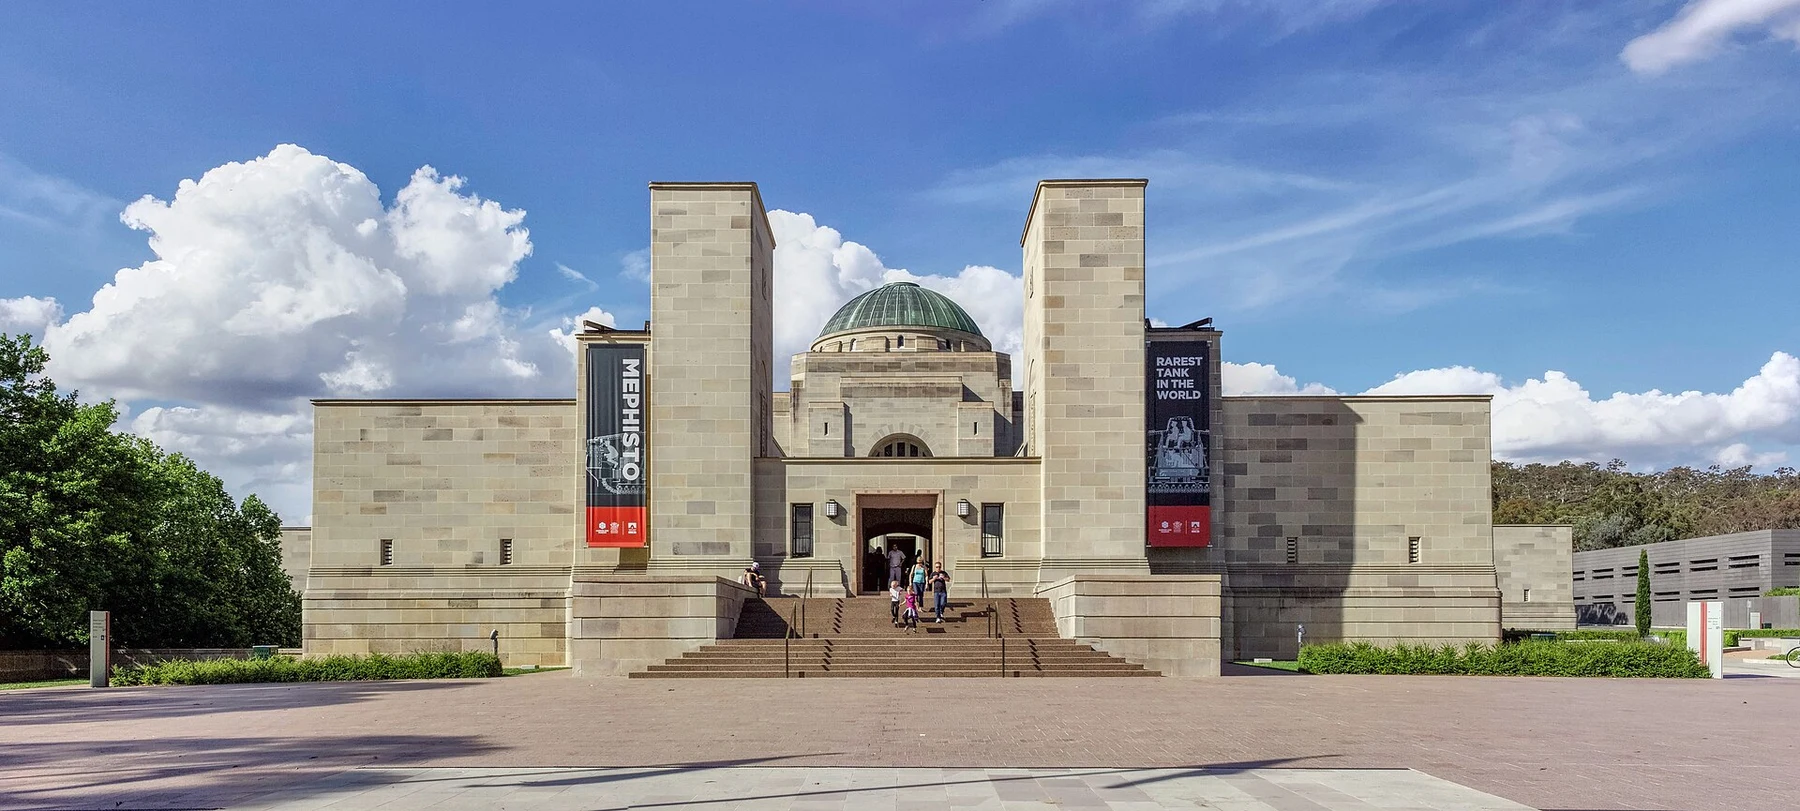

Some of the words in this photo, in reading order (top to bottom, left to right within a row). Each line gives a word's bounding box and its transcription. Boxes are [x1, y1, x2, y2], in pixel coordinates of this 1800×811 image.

[1156, 357, 1203, 366] RAREST
[1156, 368, 1189, 377] TANK
[1156, 379, 1169, 389] IN
[1171, 379, 1194, 389] THE
[1156, 390, 1201, 400] WORLD
[622, 358, 640, 481] MEPHISTO
